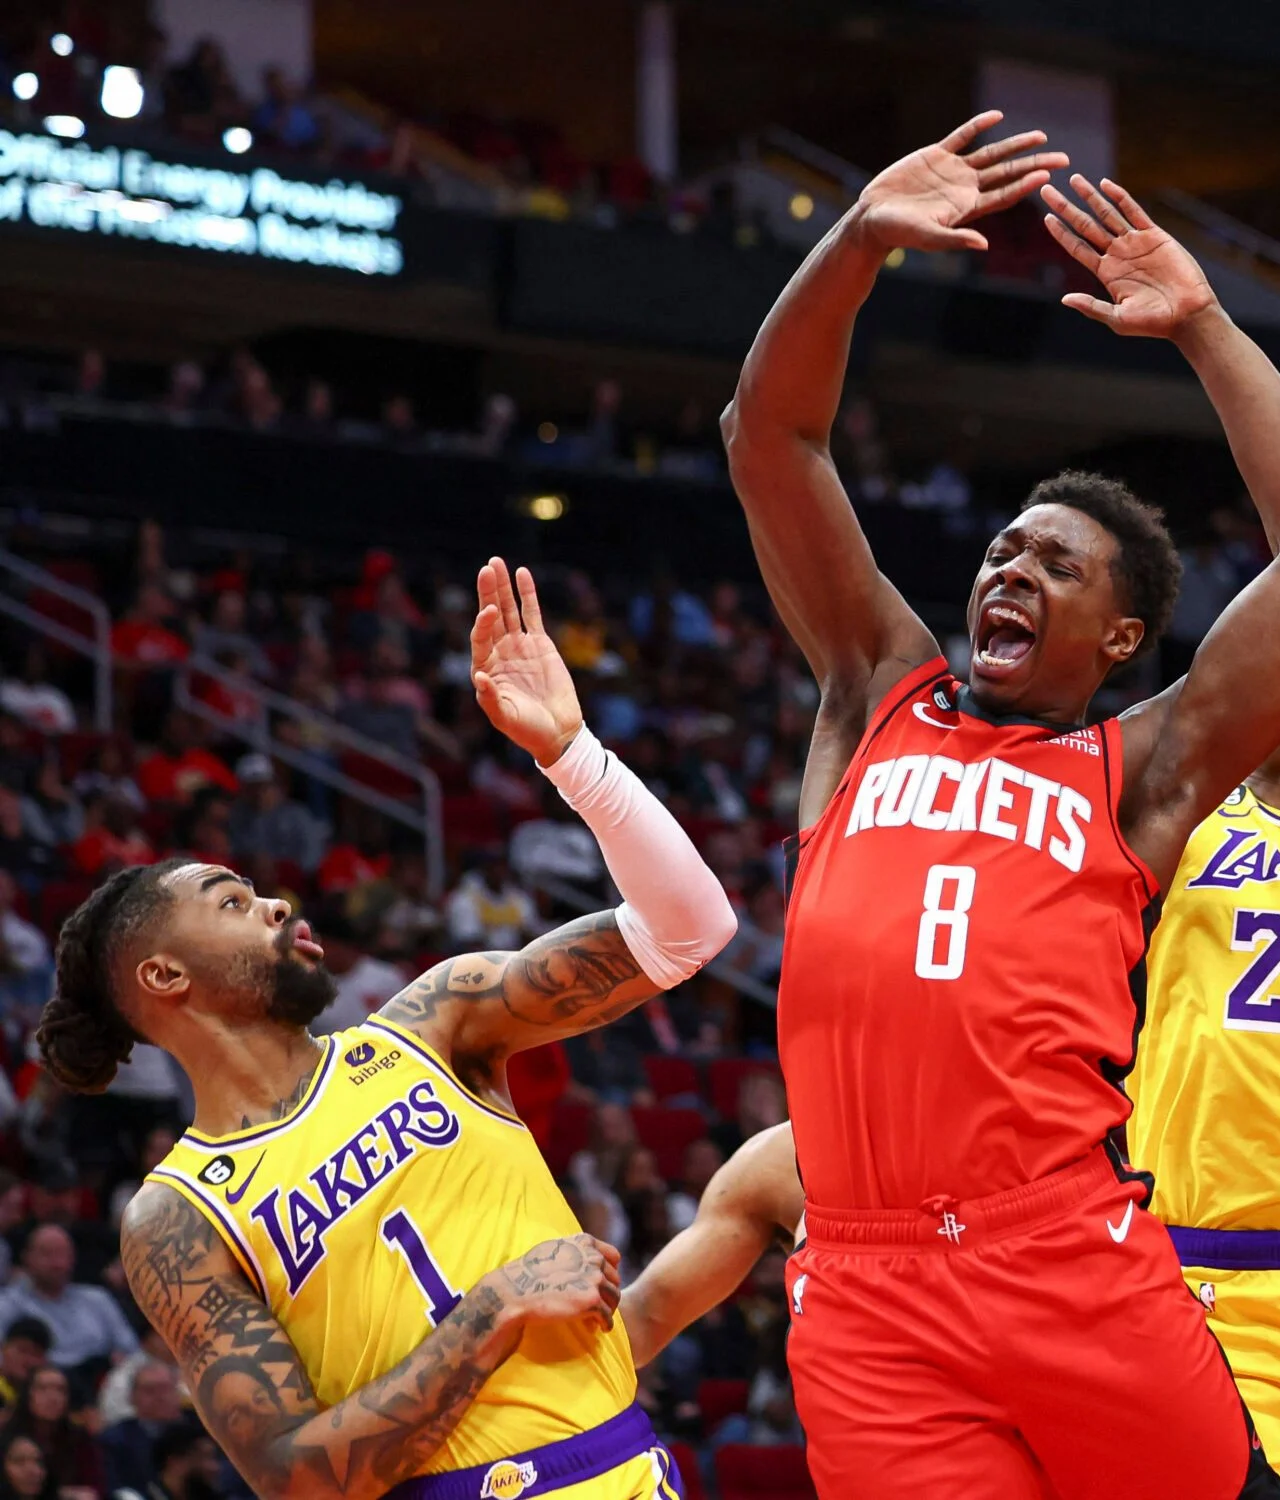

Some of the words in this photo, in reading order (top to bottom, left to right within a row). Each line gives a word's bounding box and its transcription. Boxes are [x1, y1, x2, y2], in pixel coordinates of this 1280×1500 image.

[251, 167, 400, 231] Provider
[1036, 737, 1100, 757] arma
[845, 754, 1092, 872] ROCKETS
[915, 864, 976, 980] 8
[349, 1050, 401, 1086] bibigo
[204, 1159, 231, 1184] 6
[249, 1081, 461, 1298] LAKERS
[379, 1206, 464, 1329] 1
[482, 1468, 537, 1496] LAKERS
